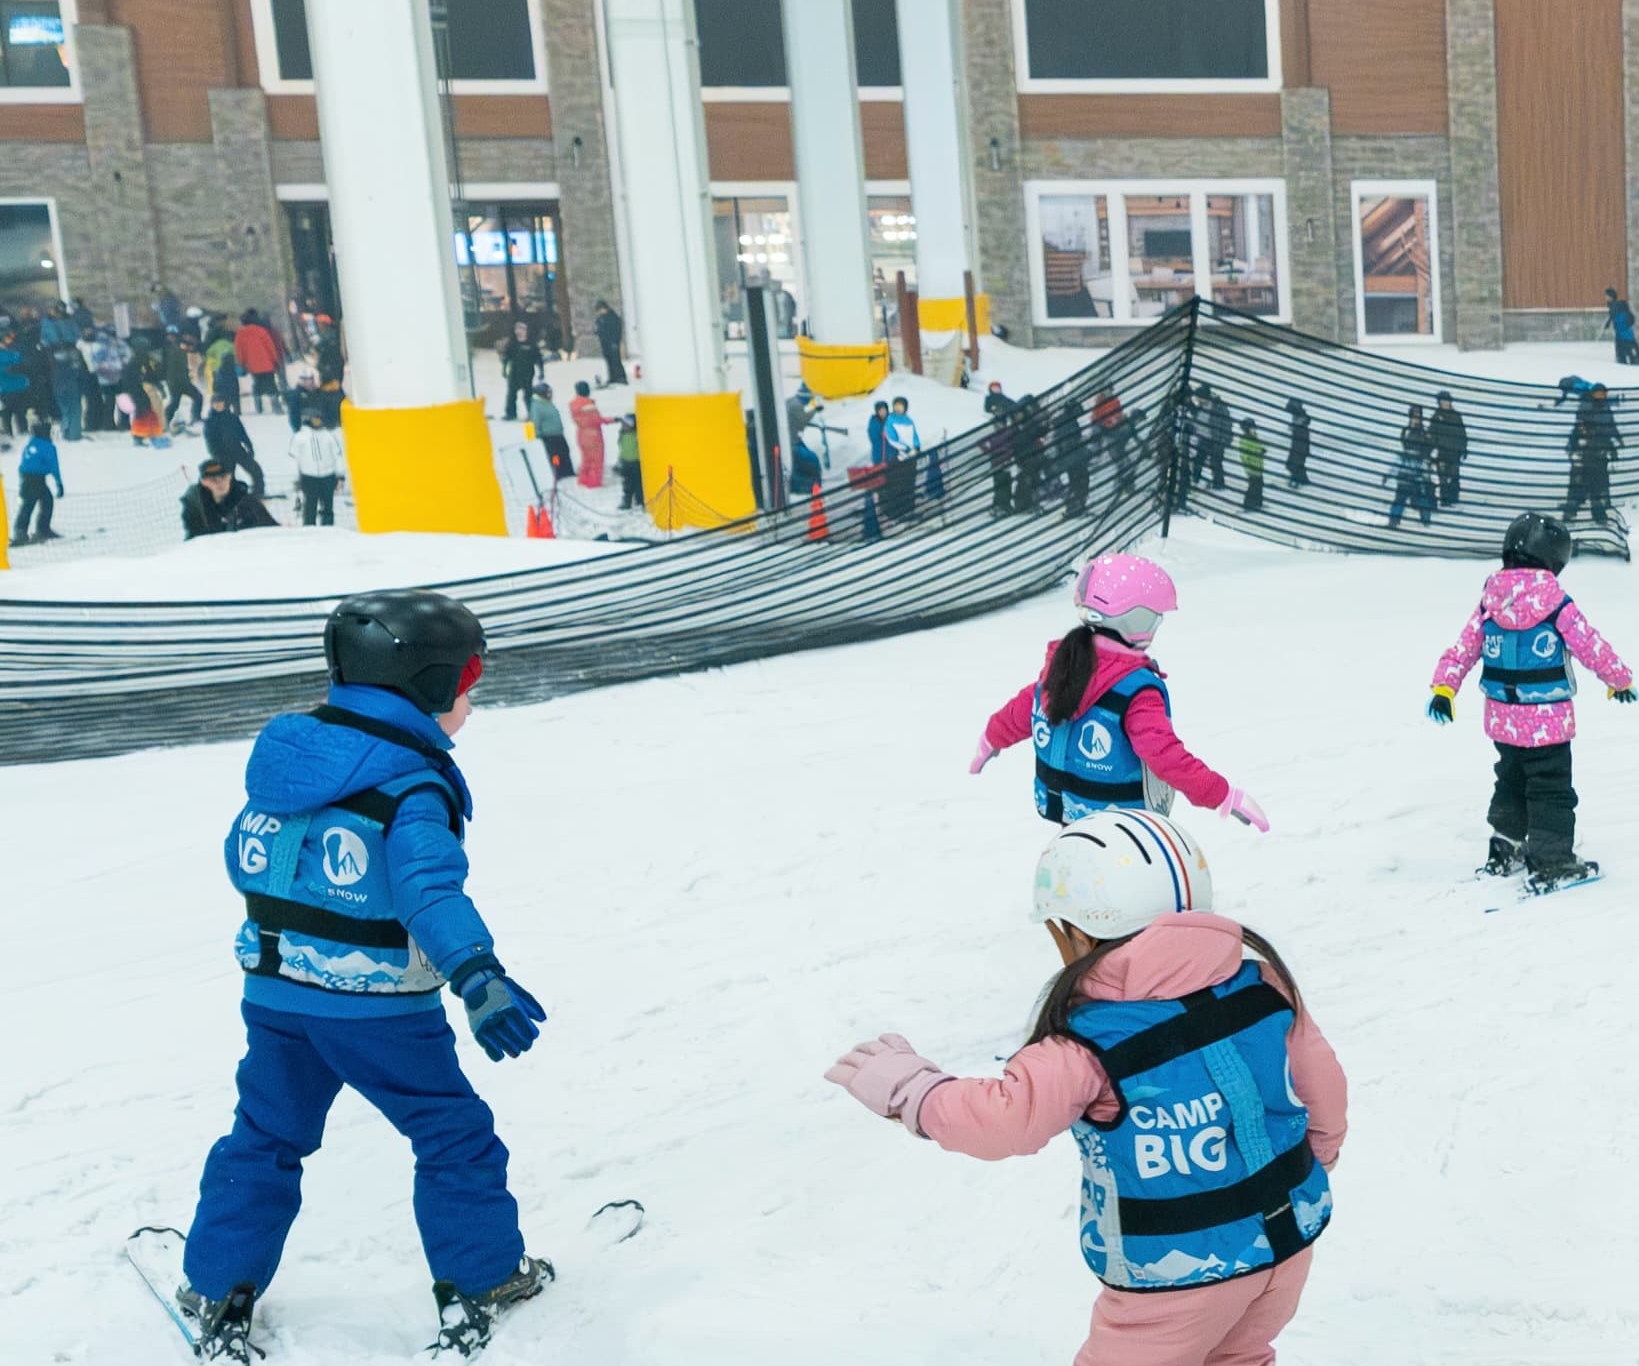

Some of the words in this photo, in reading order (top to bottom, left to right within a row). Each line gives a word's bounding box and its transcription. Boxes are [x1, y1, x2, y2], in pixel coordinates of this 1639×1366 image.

[1085, 761, 1113, 772] SNOW
[241, 810, 282, 836] MP
[327, 887, 368, 904] SNOW
[1129, 1092, 1223, 1130] CAMP
[1134, 1126, 1227, 1180] BIG
